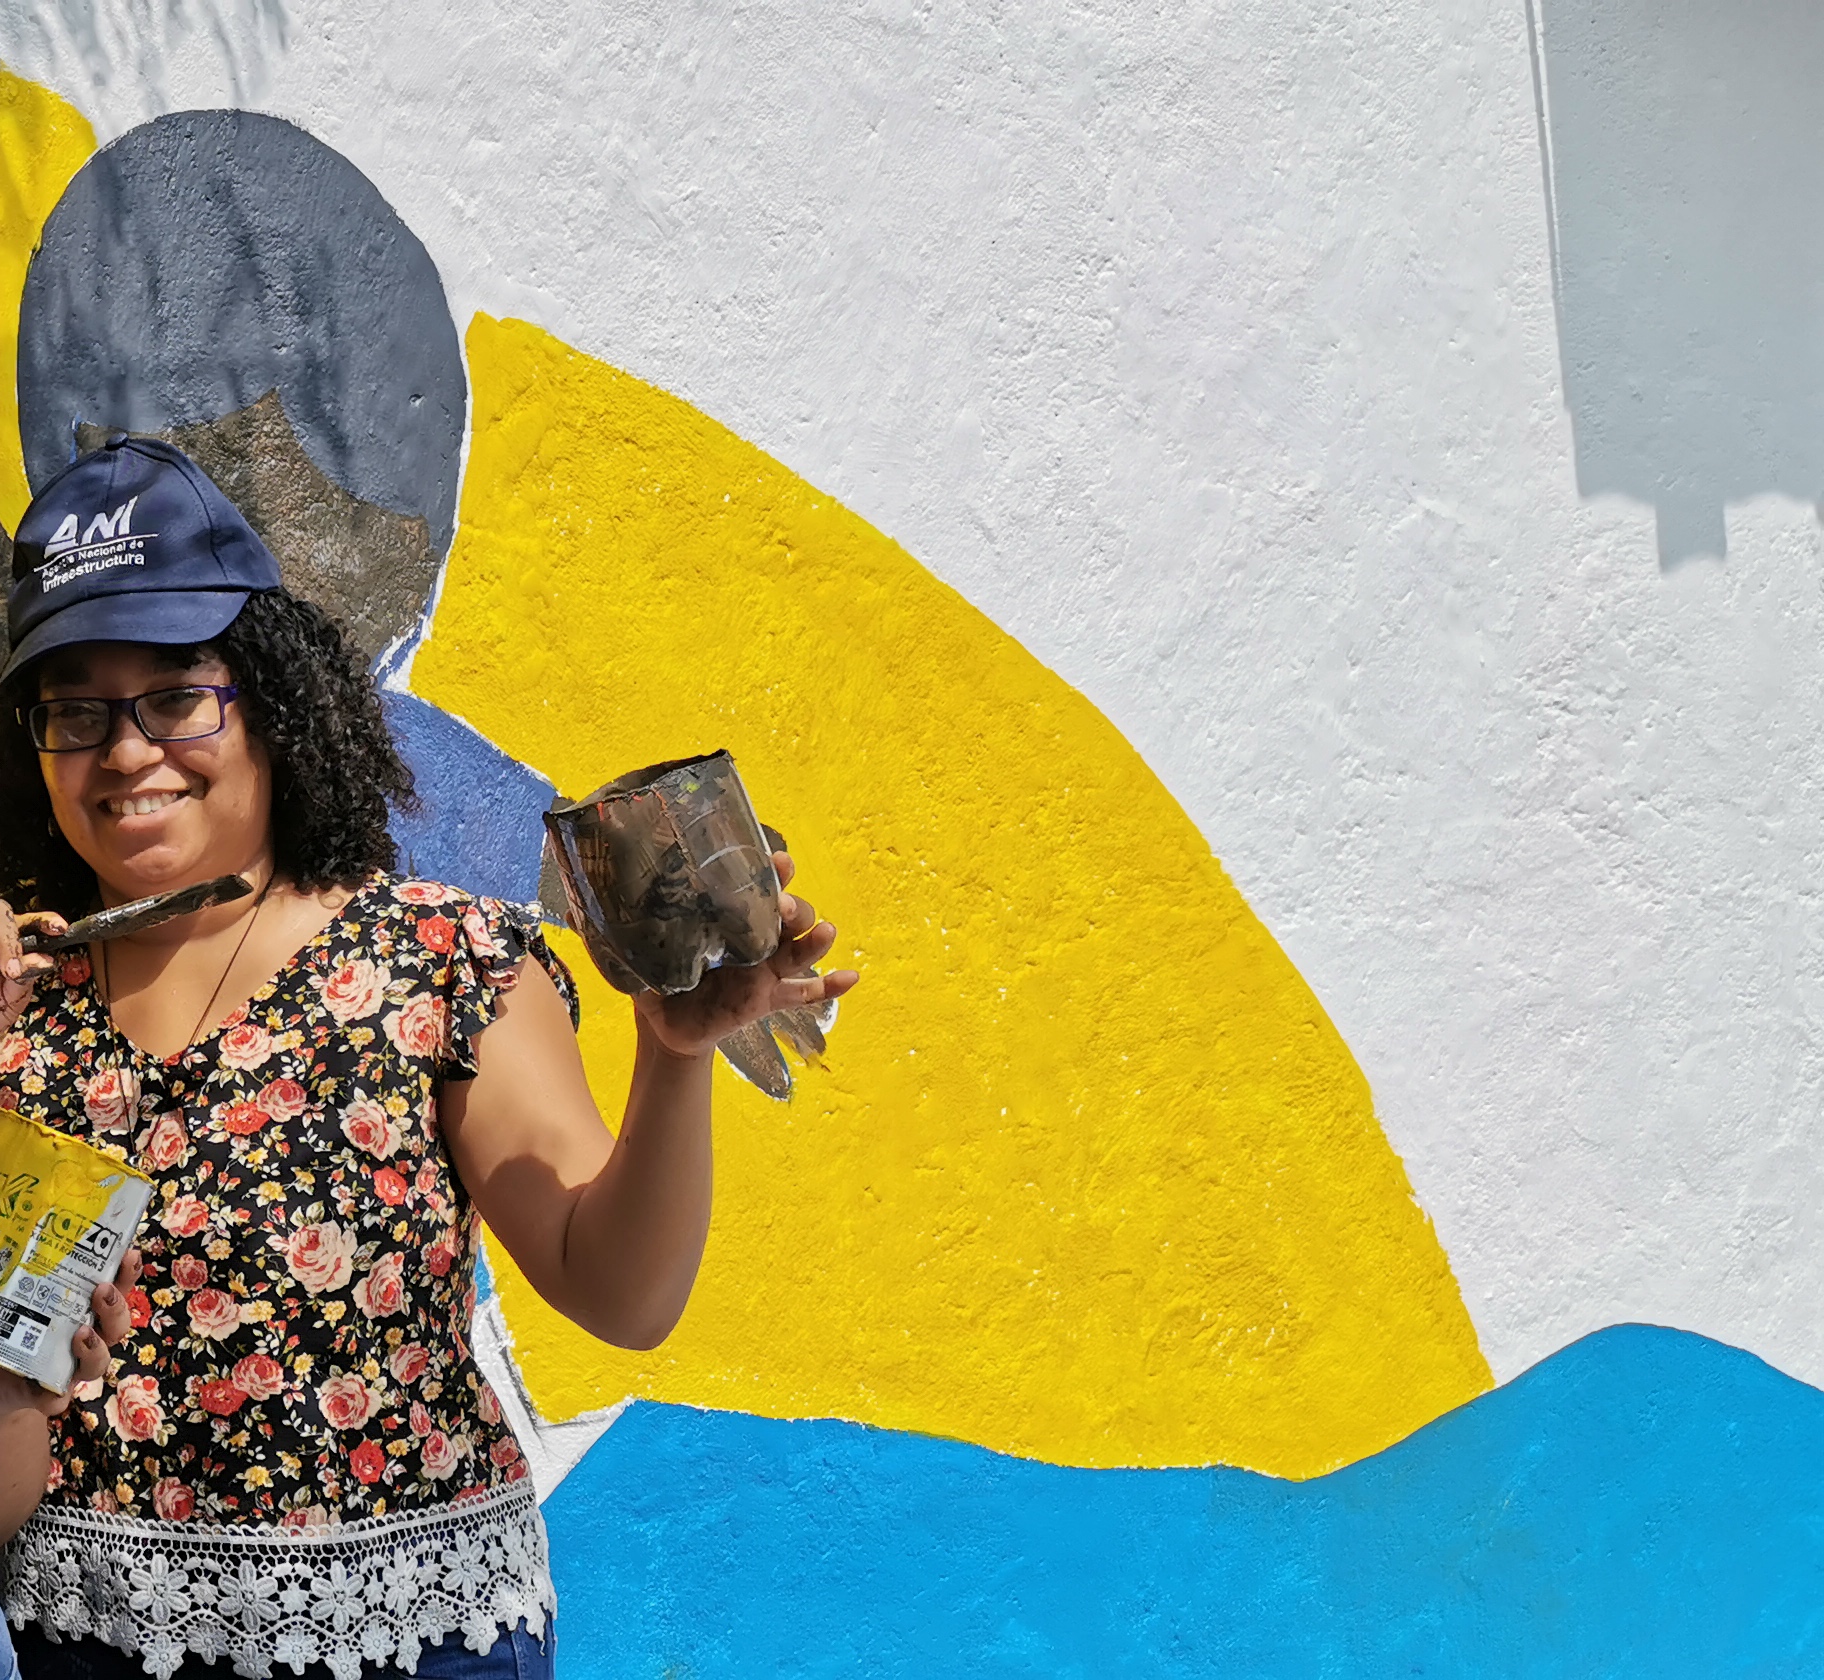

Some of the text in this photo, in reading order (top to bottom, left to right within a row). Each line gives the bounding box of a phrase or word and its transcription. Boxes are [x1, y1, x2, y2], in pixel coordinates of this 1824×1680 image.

[44, 495, 138, 559] ANI
[78, 541, 127, 561] Nacional
[129, 539, 144, 550] de
[42, 553, 145, 593] Infraestructura
